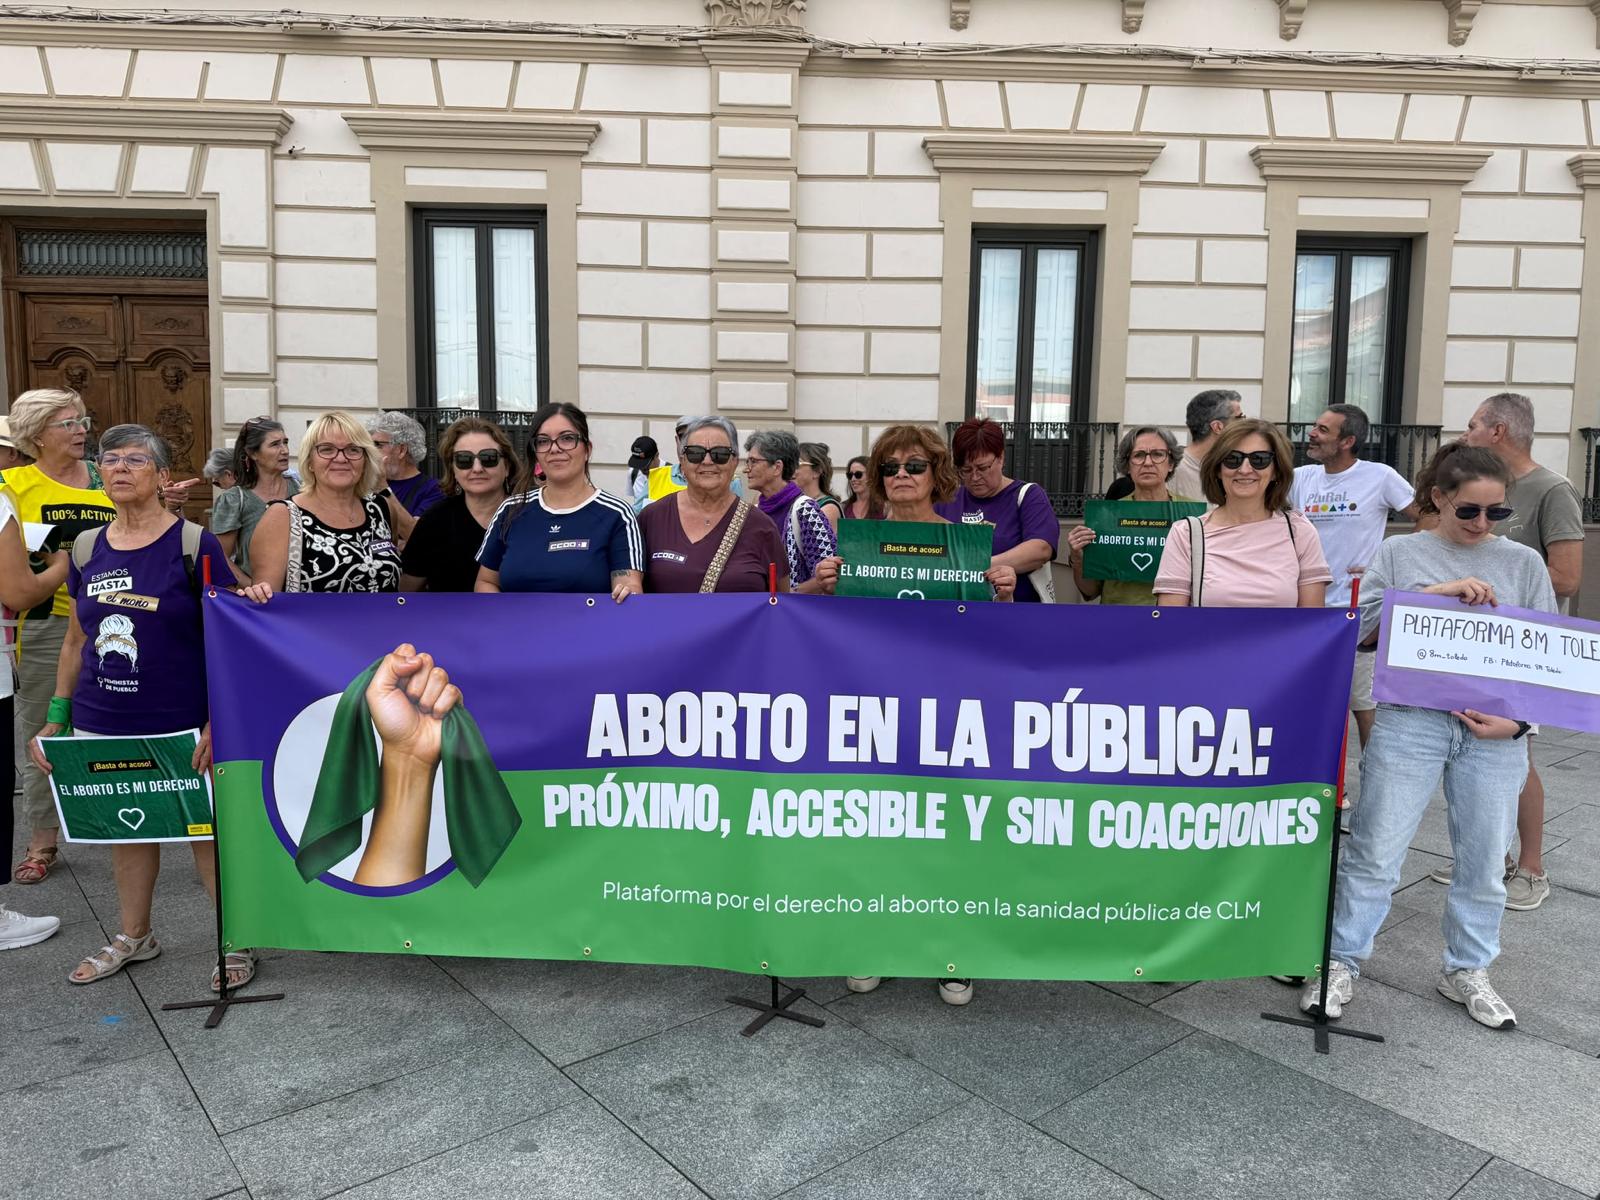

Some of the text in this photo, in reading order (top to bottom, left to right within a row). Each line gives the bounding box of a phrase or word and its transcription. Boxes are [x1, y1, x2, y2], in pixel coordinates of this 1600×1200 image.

[46, 509, 77, 521] 100%
[1098, 535, 1131, 545] ABORTO
[1134, 536, 1144, 546] ES
[1146, 537, 1157, 546] MI
[883, 544, 943, 554] ¡Basta de acoso!
[91, 568, 128, 582] ESTAMOS
[840, 564, 984, 583] EL ABORTO ES MI DERECHO
[91, 580, 128, 593] HASTA
[106, 592, 149, 608] el moño
[1403, 613, 1514, 649] PLATAFORMA
[1521, 628, 1549, 654] 8M
[586, 688, 1273, 777] ABORTO EN LA PÚBLICA:
[93, 762, 116, 771] ¡Basta
[118, 761, 128, 769] de
[59, 778, 200, 796] EL ABORTO ES MI DERECHO
[543, 772, 1321, 850] PRÓXIMO, ACCESIBLE Y SIN COACCIONES
[603, 881, 1261, 923] Plataforma por el derecho al aborto en la sanidad pública de CLM
